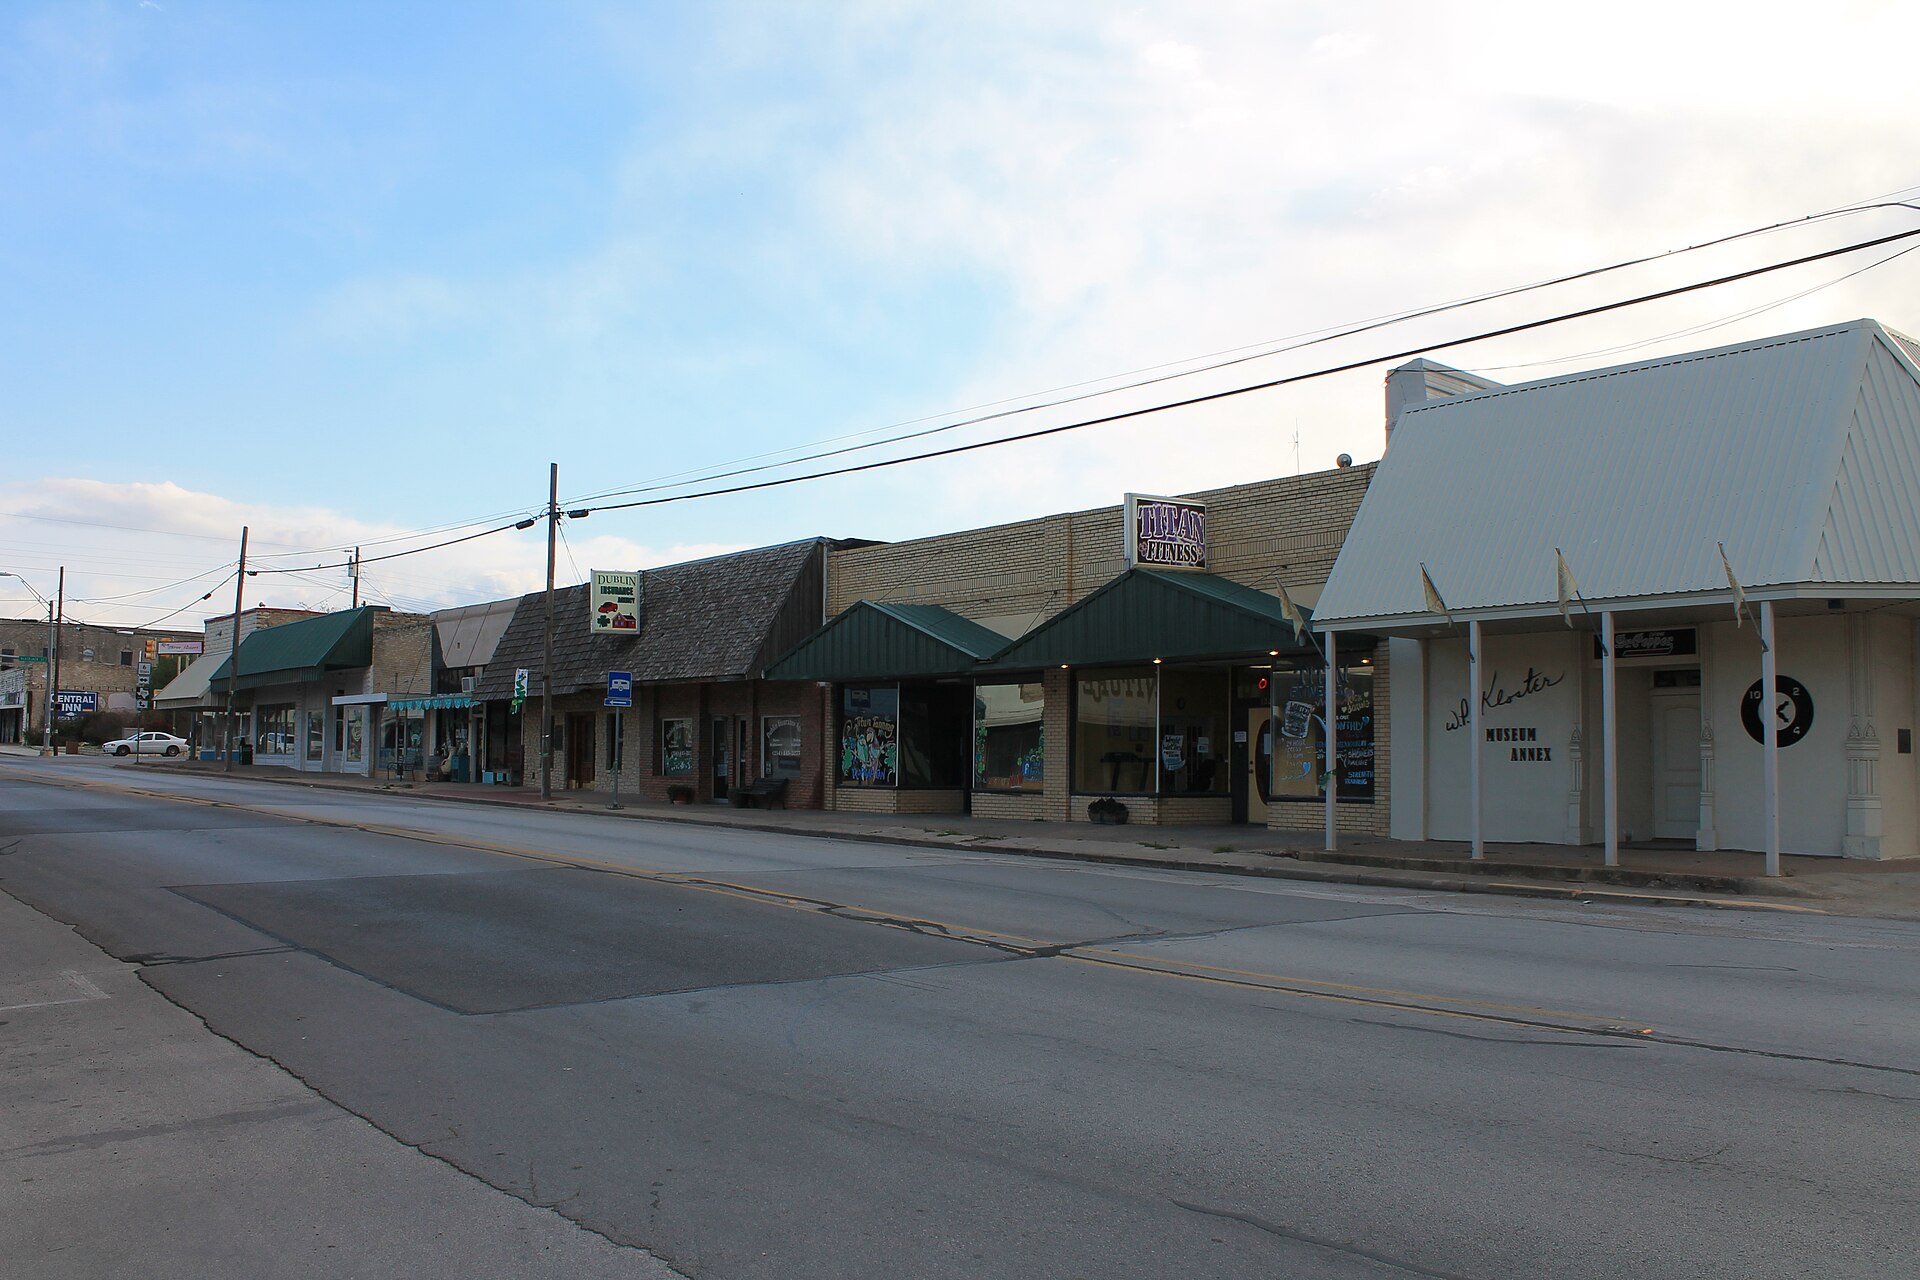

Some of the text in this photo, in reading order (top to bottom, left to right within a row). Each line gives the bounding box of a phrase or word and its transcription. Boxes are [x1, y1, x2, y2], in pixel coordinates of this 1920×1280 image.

[1138, 504, 1205, 545] TITAN
[1146, 540, 1198, 564] FITNESS
[598, 575, 636, 586] DUBLIN
[600, 586, 634, 596] INSURANCE
[1481, 667, 1565, 715] Kloster
[1749, 687, 1800, 699] 10 2
[61, 703, 82, 711] INN
[1486, 728, 1536, 742] MUSEUM
[1793, 726, 1800, 735] 4
[1511, 748, 1552, 761] ANNEX
